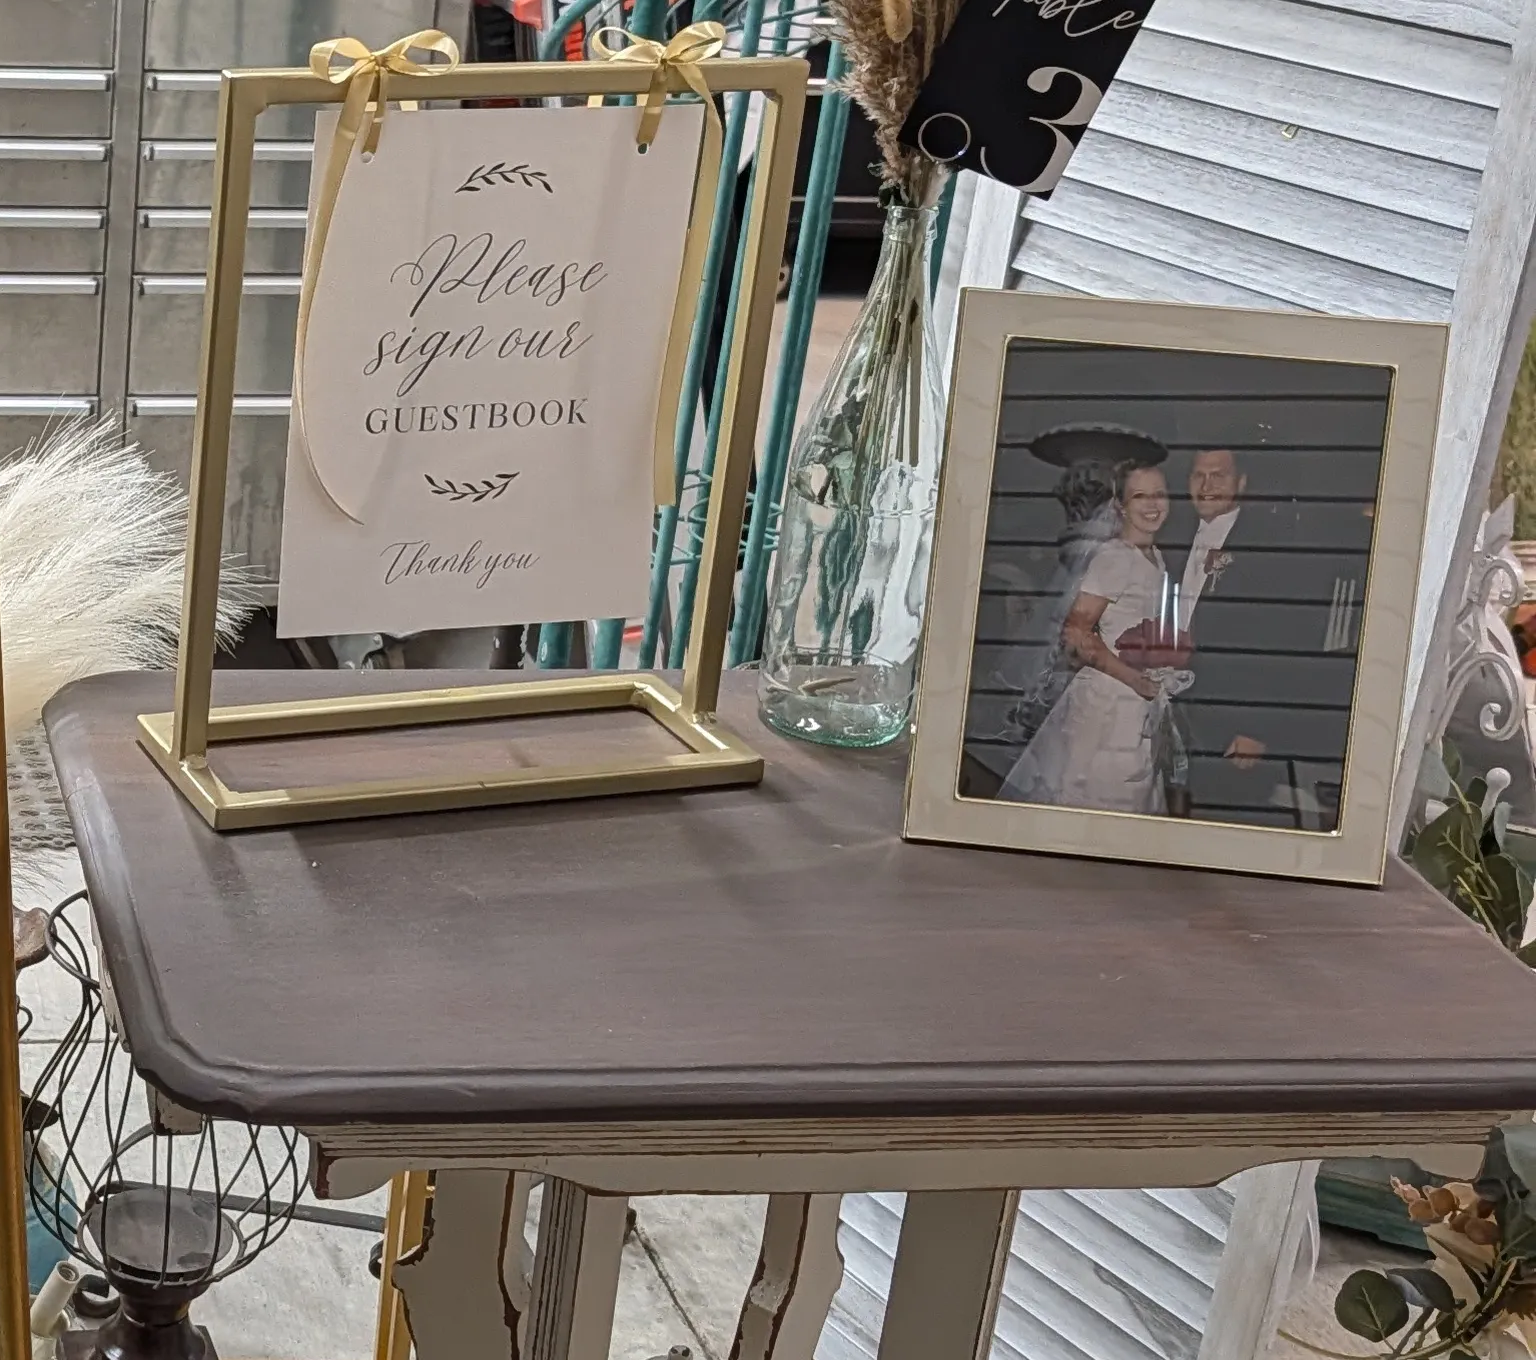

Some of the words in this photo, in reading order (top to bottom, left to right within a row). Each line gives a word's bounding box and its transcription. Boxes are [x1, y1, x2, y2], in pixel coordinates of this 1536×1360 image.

[390, 232, 608, 318] Please
[363, 325, 493, 398] sign
[497, 320, 594, 359] our
[364, 397, 589, 435] GUESTBOOK
[379, 539, 482, 585] Thank
[476, 552, 541, 590] you
